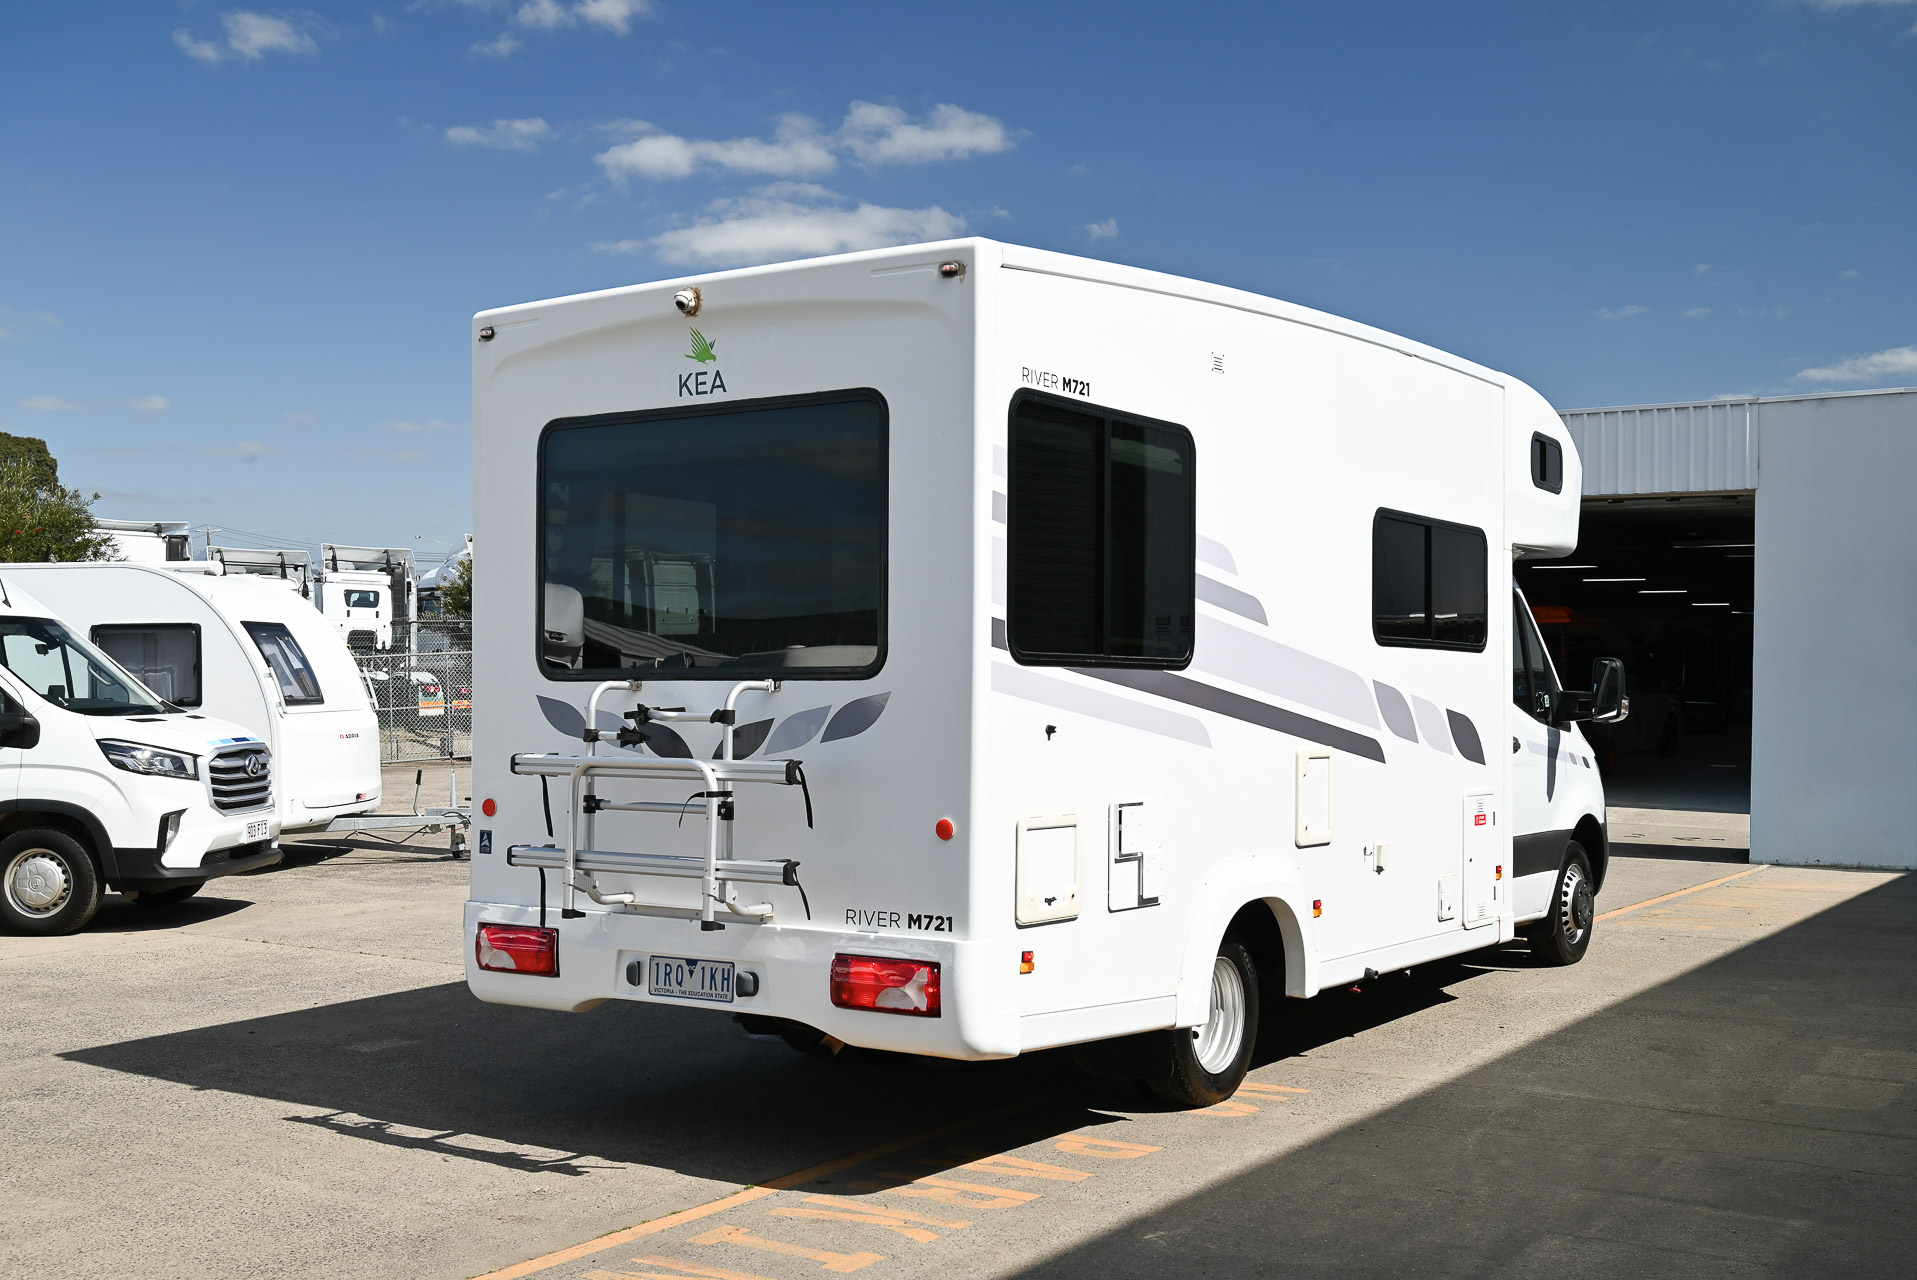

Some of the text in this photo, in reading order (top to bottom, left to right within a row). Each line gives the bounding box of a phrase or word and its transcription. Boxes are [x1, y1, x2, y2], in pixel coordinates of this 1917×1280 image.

[678, 369, 727, 398] KEA
[1022, 366, 1090, 397] RIVER M721
[845, 909, 953, 933] RIVER M721
[654, 962, 731, 992] 1RQ 1KH
